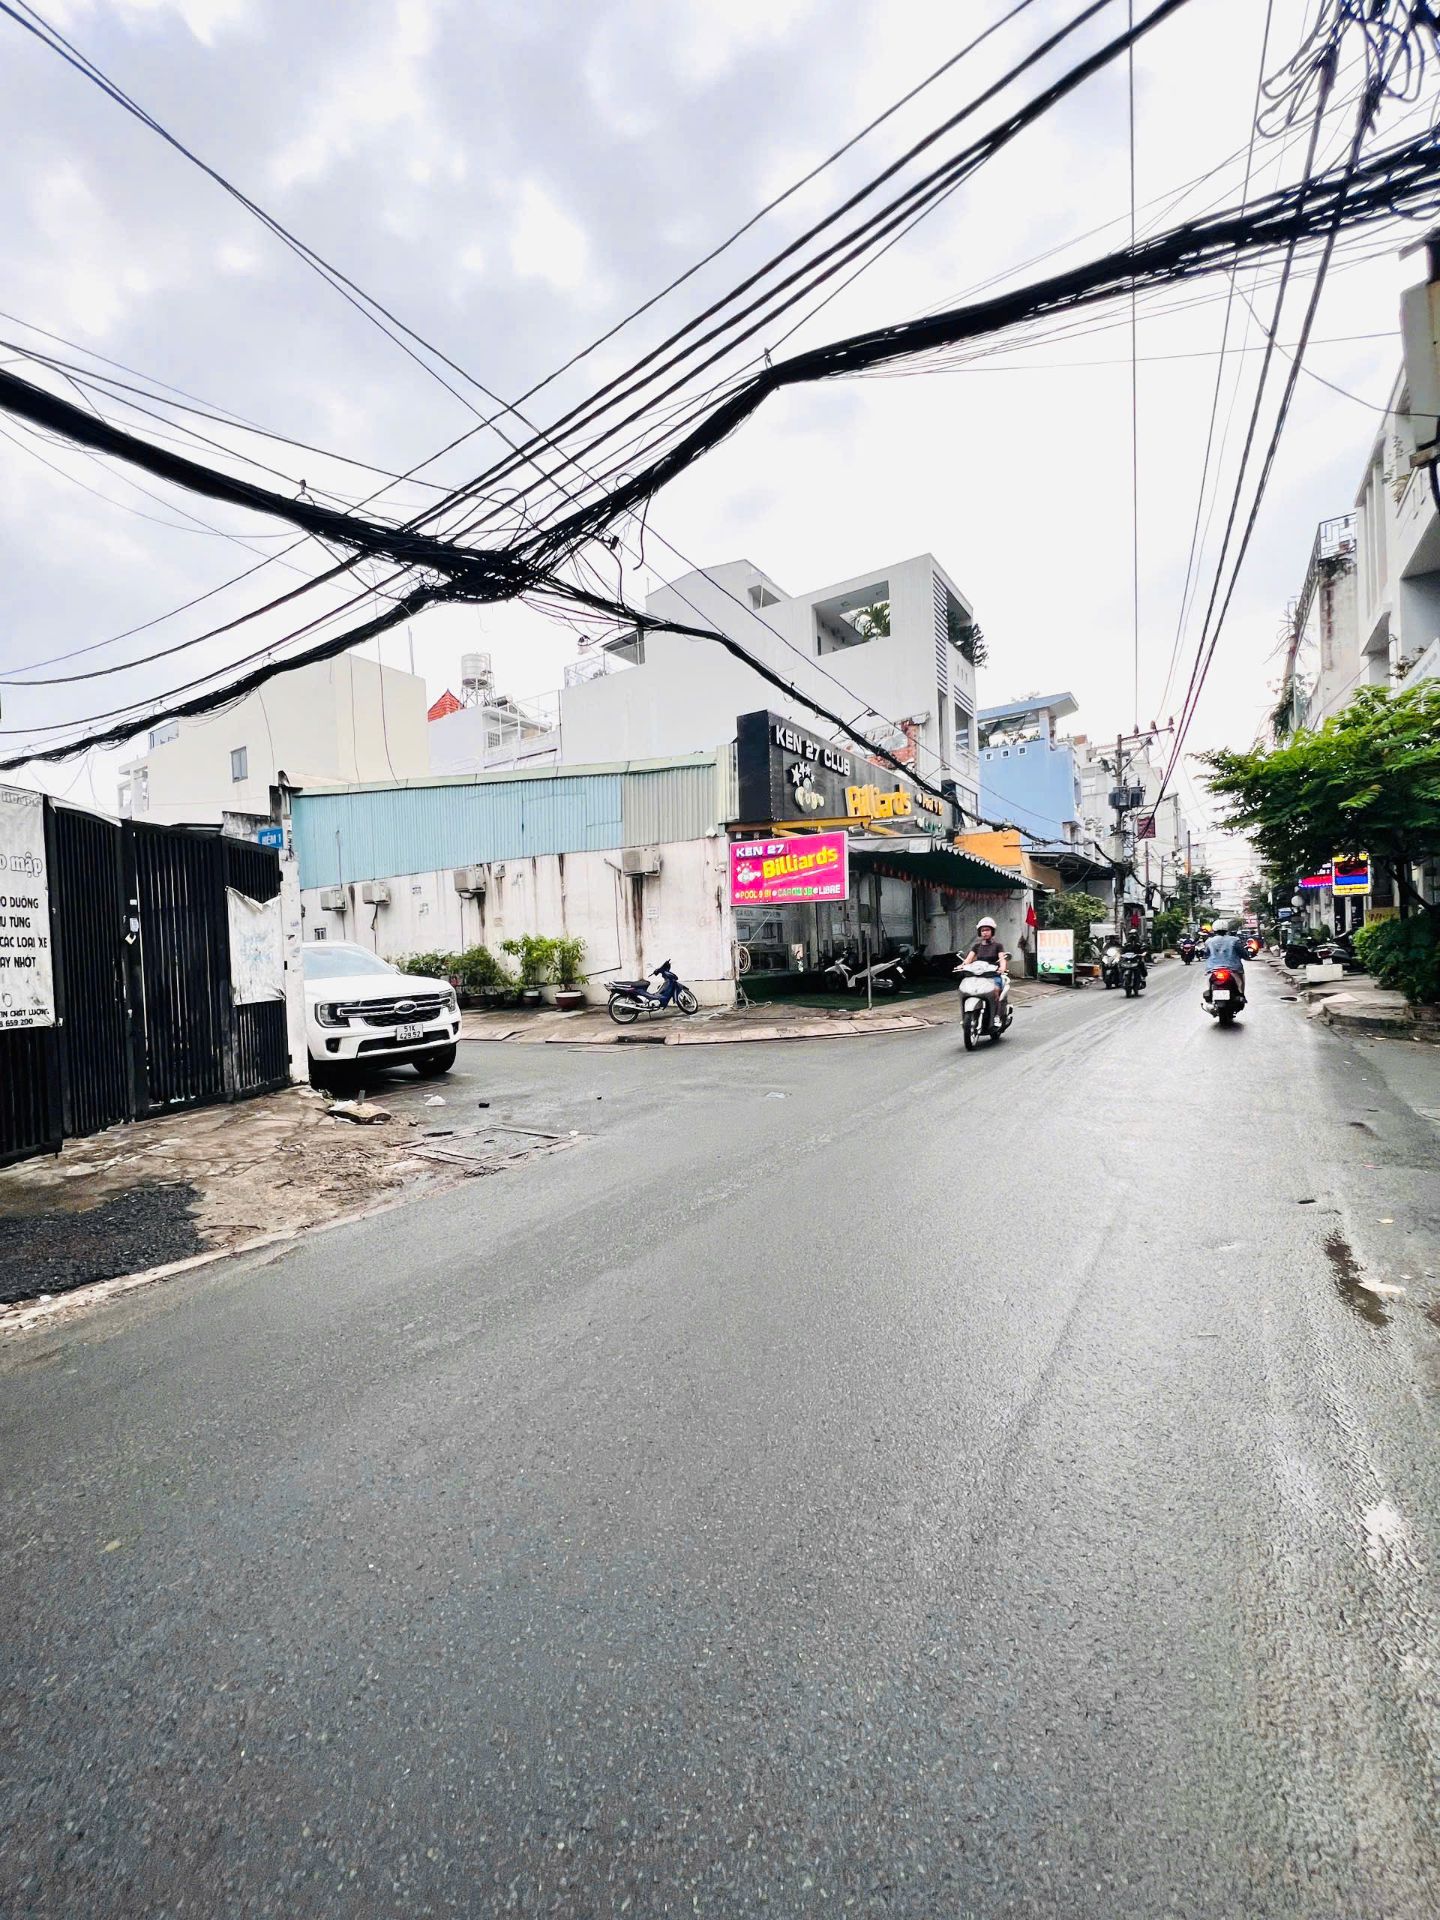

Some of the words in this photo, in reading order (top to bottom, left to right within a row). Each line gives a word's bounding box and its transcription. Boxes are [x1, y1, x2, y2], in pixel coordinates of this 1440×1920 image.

[776, 725, 801, 754] KEN
[806, 740, 819, 761] 27
[824, 748, 850, 777] CLUB
[736, 846, 763, 857] KEN
[767, 844, 784, 854] 27
[763, 846, 838, 878] Billiards
[740, 890, 758, 899] POOL
[819, 884, 840, 894] LIBRE
[38, 937, 47, 948] XE
